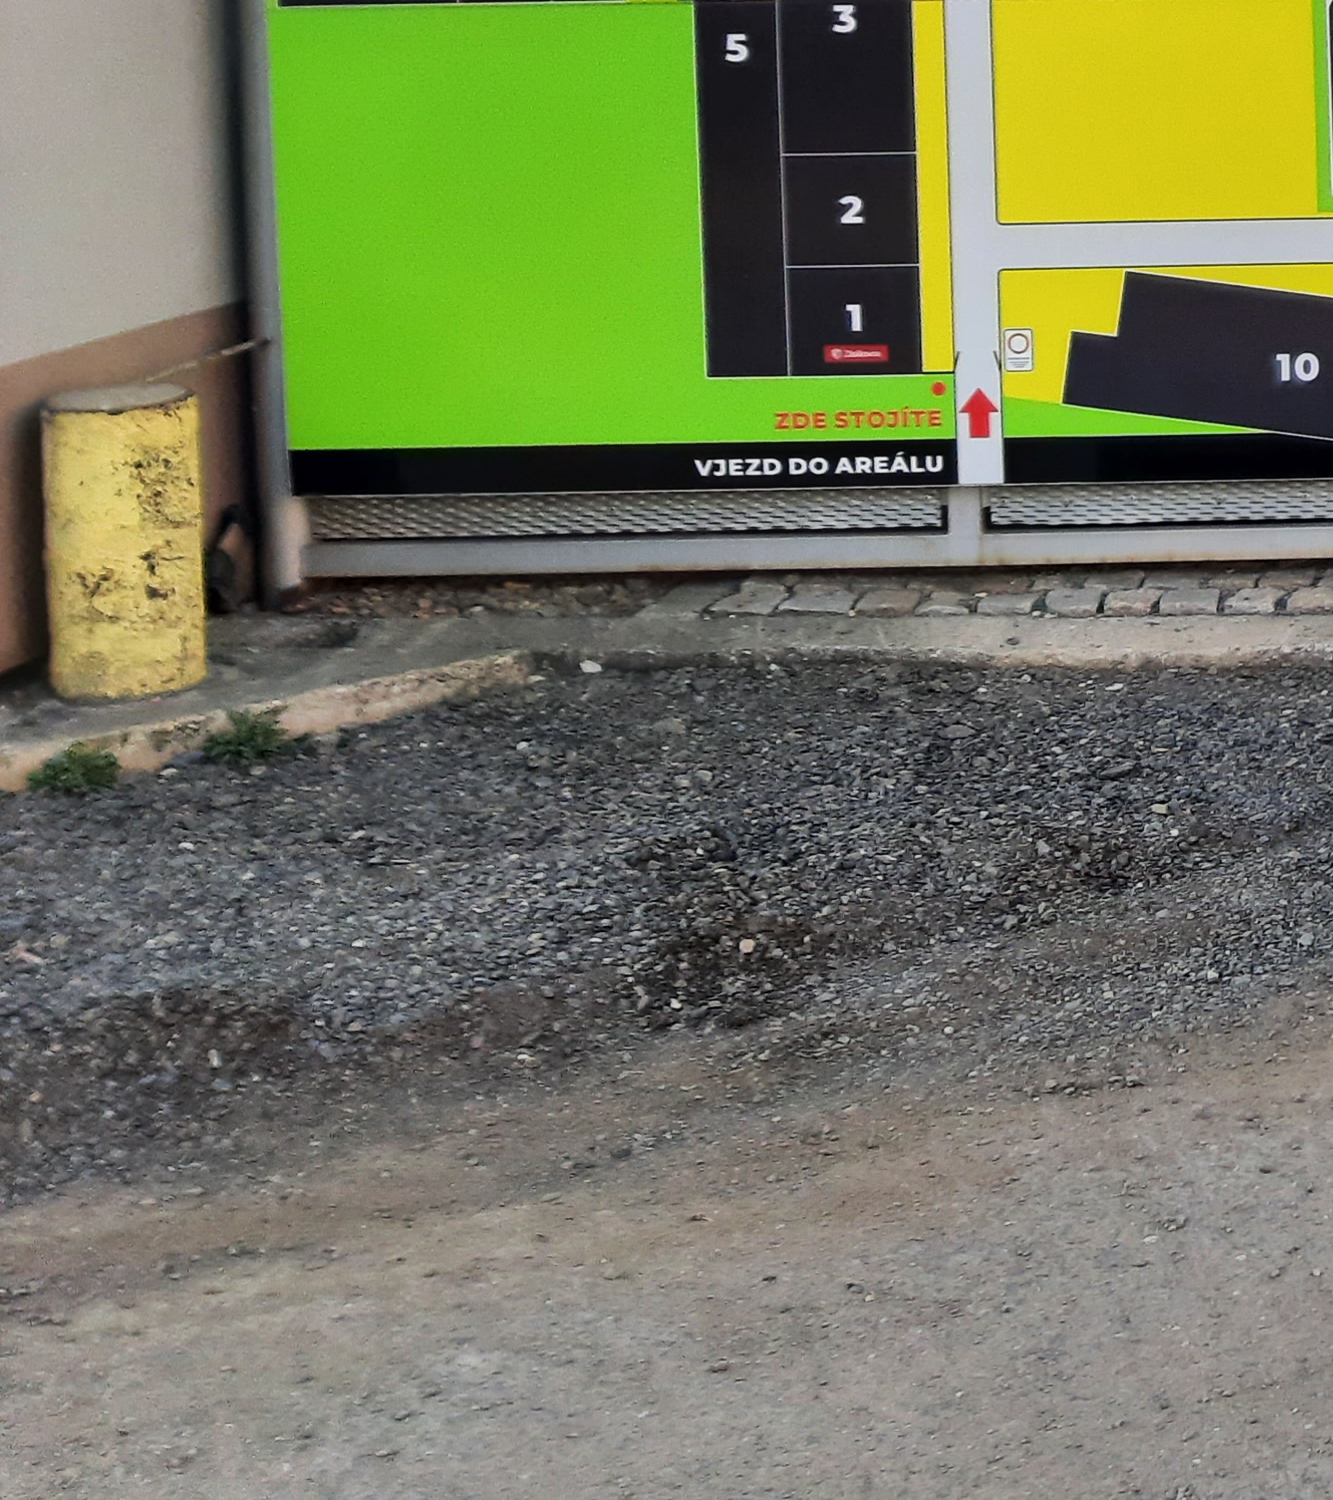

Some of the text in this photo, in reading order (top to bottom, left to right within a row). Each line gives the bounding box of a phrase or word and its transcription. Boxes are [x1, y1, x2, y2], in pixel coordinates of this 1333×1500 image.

[831, 4, 857, 34] 3
[724, 33, 749, 63] 5
[838, 195, 865, 224] 2
[845, 303, 863, 332] 1
[1275, 352, 1320, 382] 10
[774, 405, 943, 430] ZDE STOJÍTE
[693, 451, 944, 477] VJEZD DO AREÁLU
